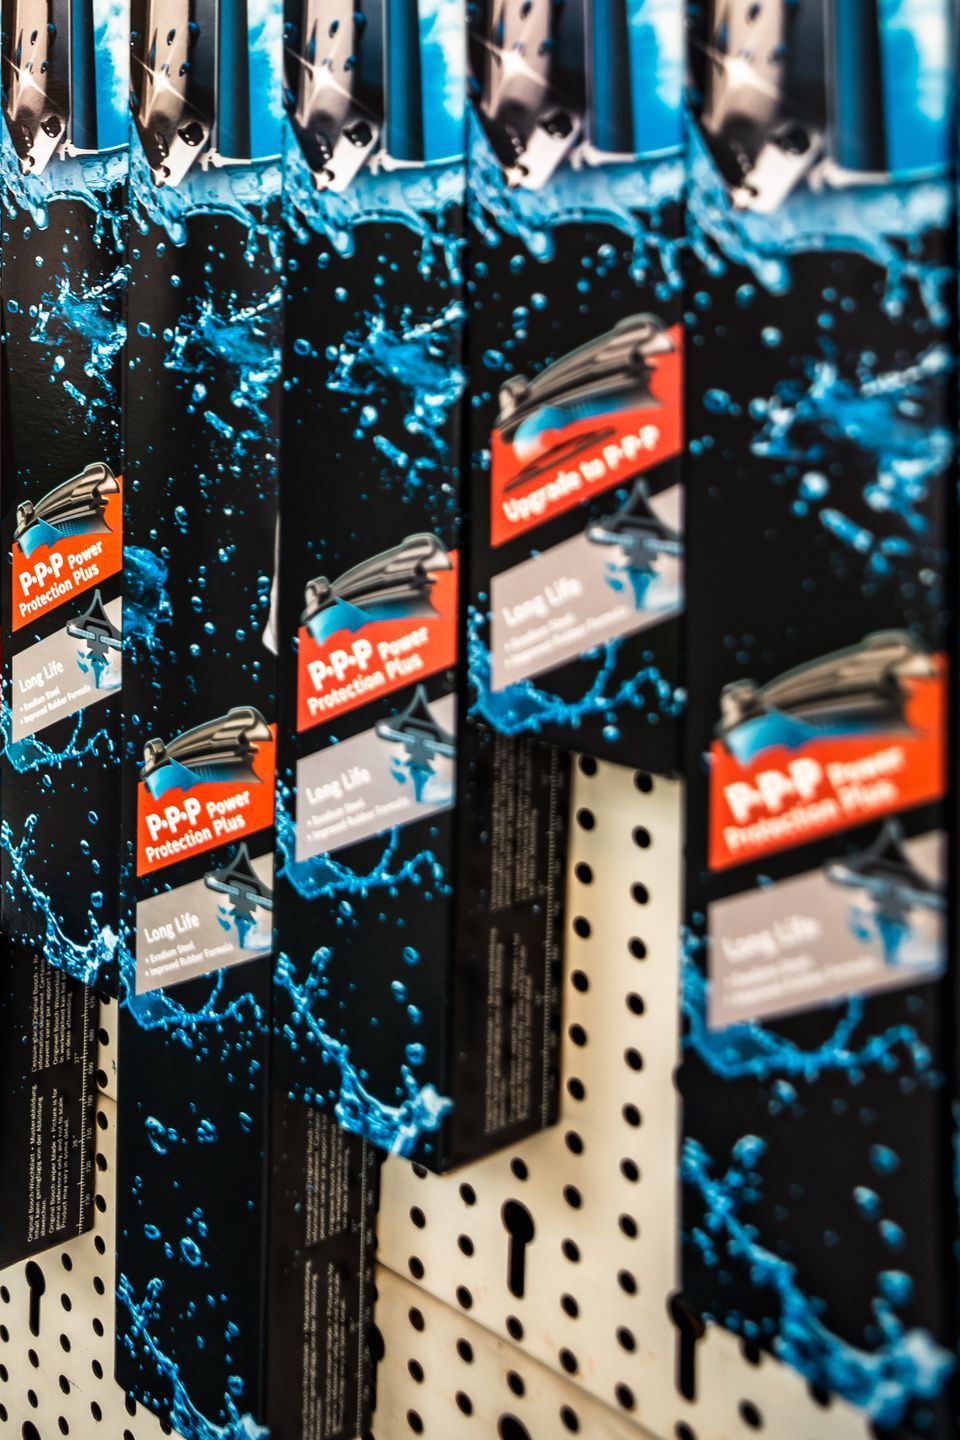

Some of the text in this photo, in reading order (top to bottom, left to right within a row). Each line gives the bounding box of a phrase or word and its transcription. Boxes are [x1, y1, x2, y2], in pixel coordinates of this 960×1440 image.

[502, 468, 582, 524] Upgrade
[580, 454, 605, 483] to
[67, 540, 103, 570] Power
[18, 562, 100, 618] Protection Plus
[377, 626, 429, 661] Power
[18, 660, 65, 694] Long Life
[306, 654, 424, 716] Protection Plus
[305, 766, 372, 806] Long Life
[826, 745, 907, 787] Power
[205, 789, 251, 819] Power
[723, 777, 900, 855] Protection Plus
[144, 813, 247, 864] Protection Plus
[143, 912, 201, 944] Long Life
